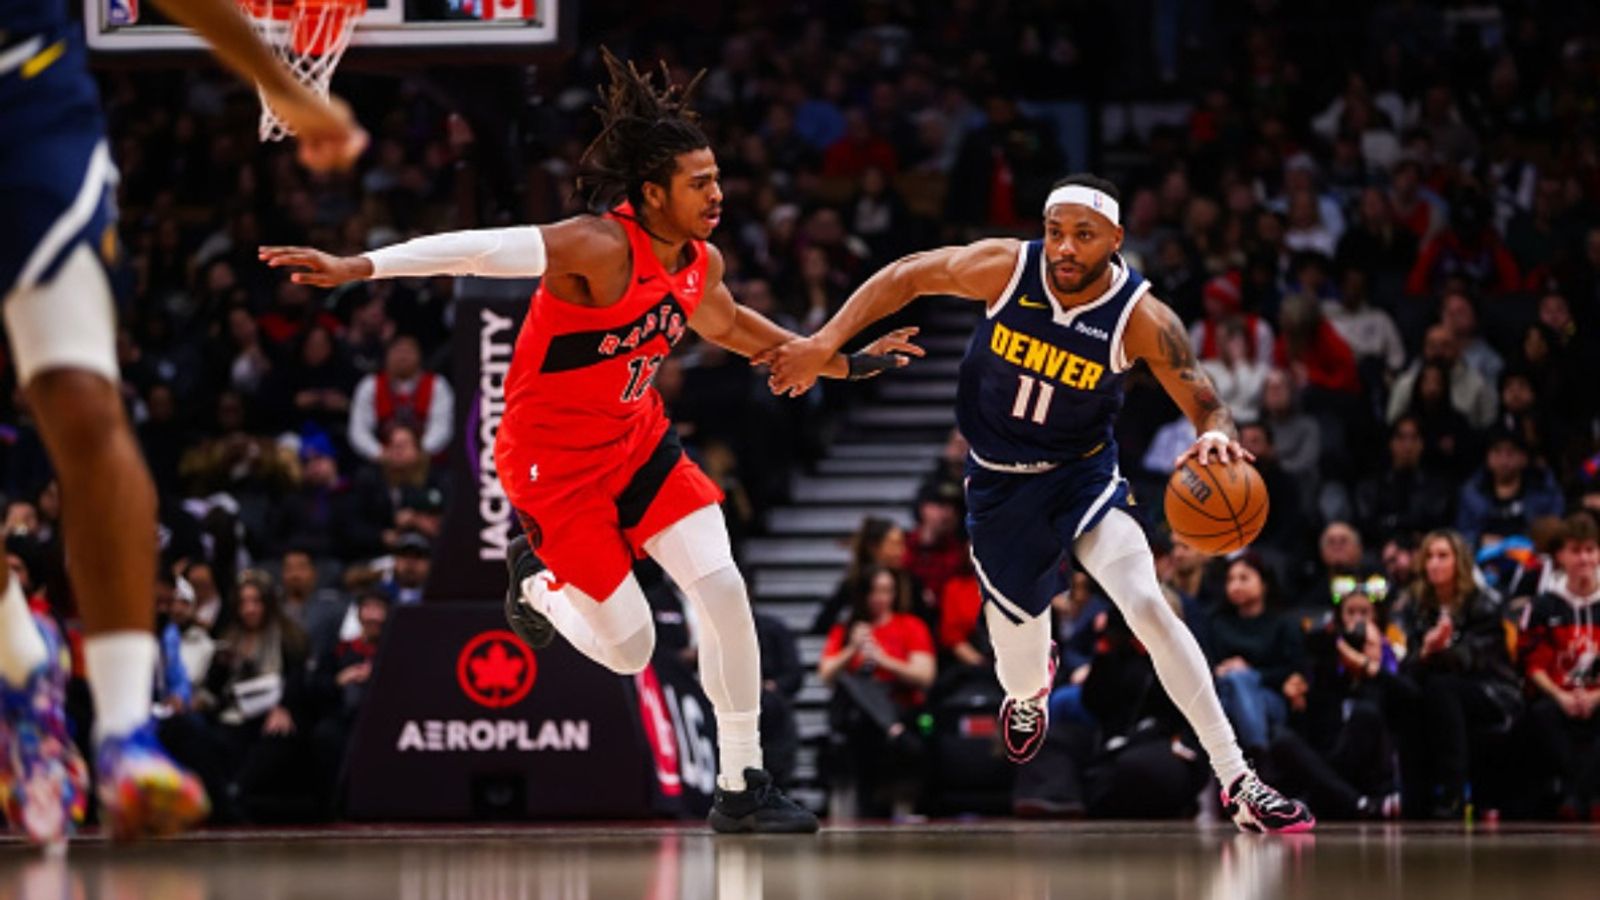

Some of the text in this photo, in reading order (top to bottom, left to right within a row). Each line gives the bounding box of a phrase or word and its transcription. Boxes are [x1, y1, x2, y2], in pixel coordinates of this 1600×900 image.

[991, 322, 1105, 390] DENVER
[1012, 374, 1055, 425] 11
[398, 720, 589, 750] AEROPLAN
